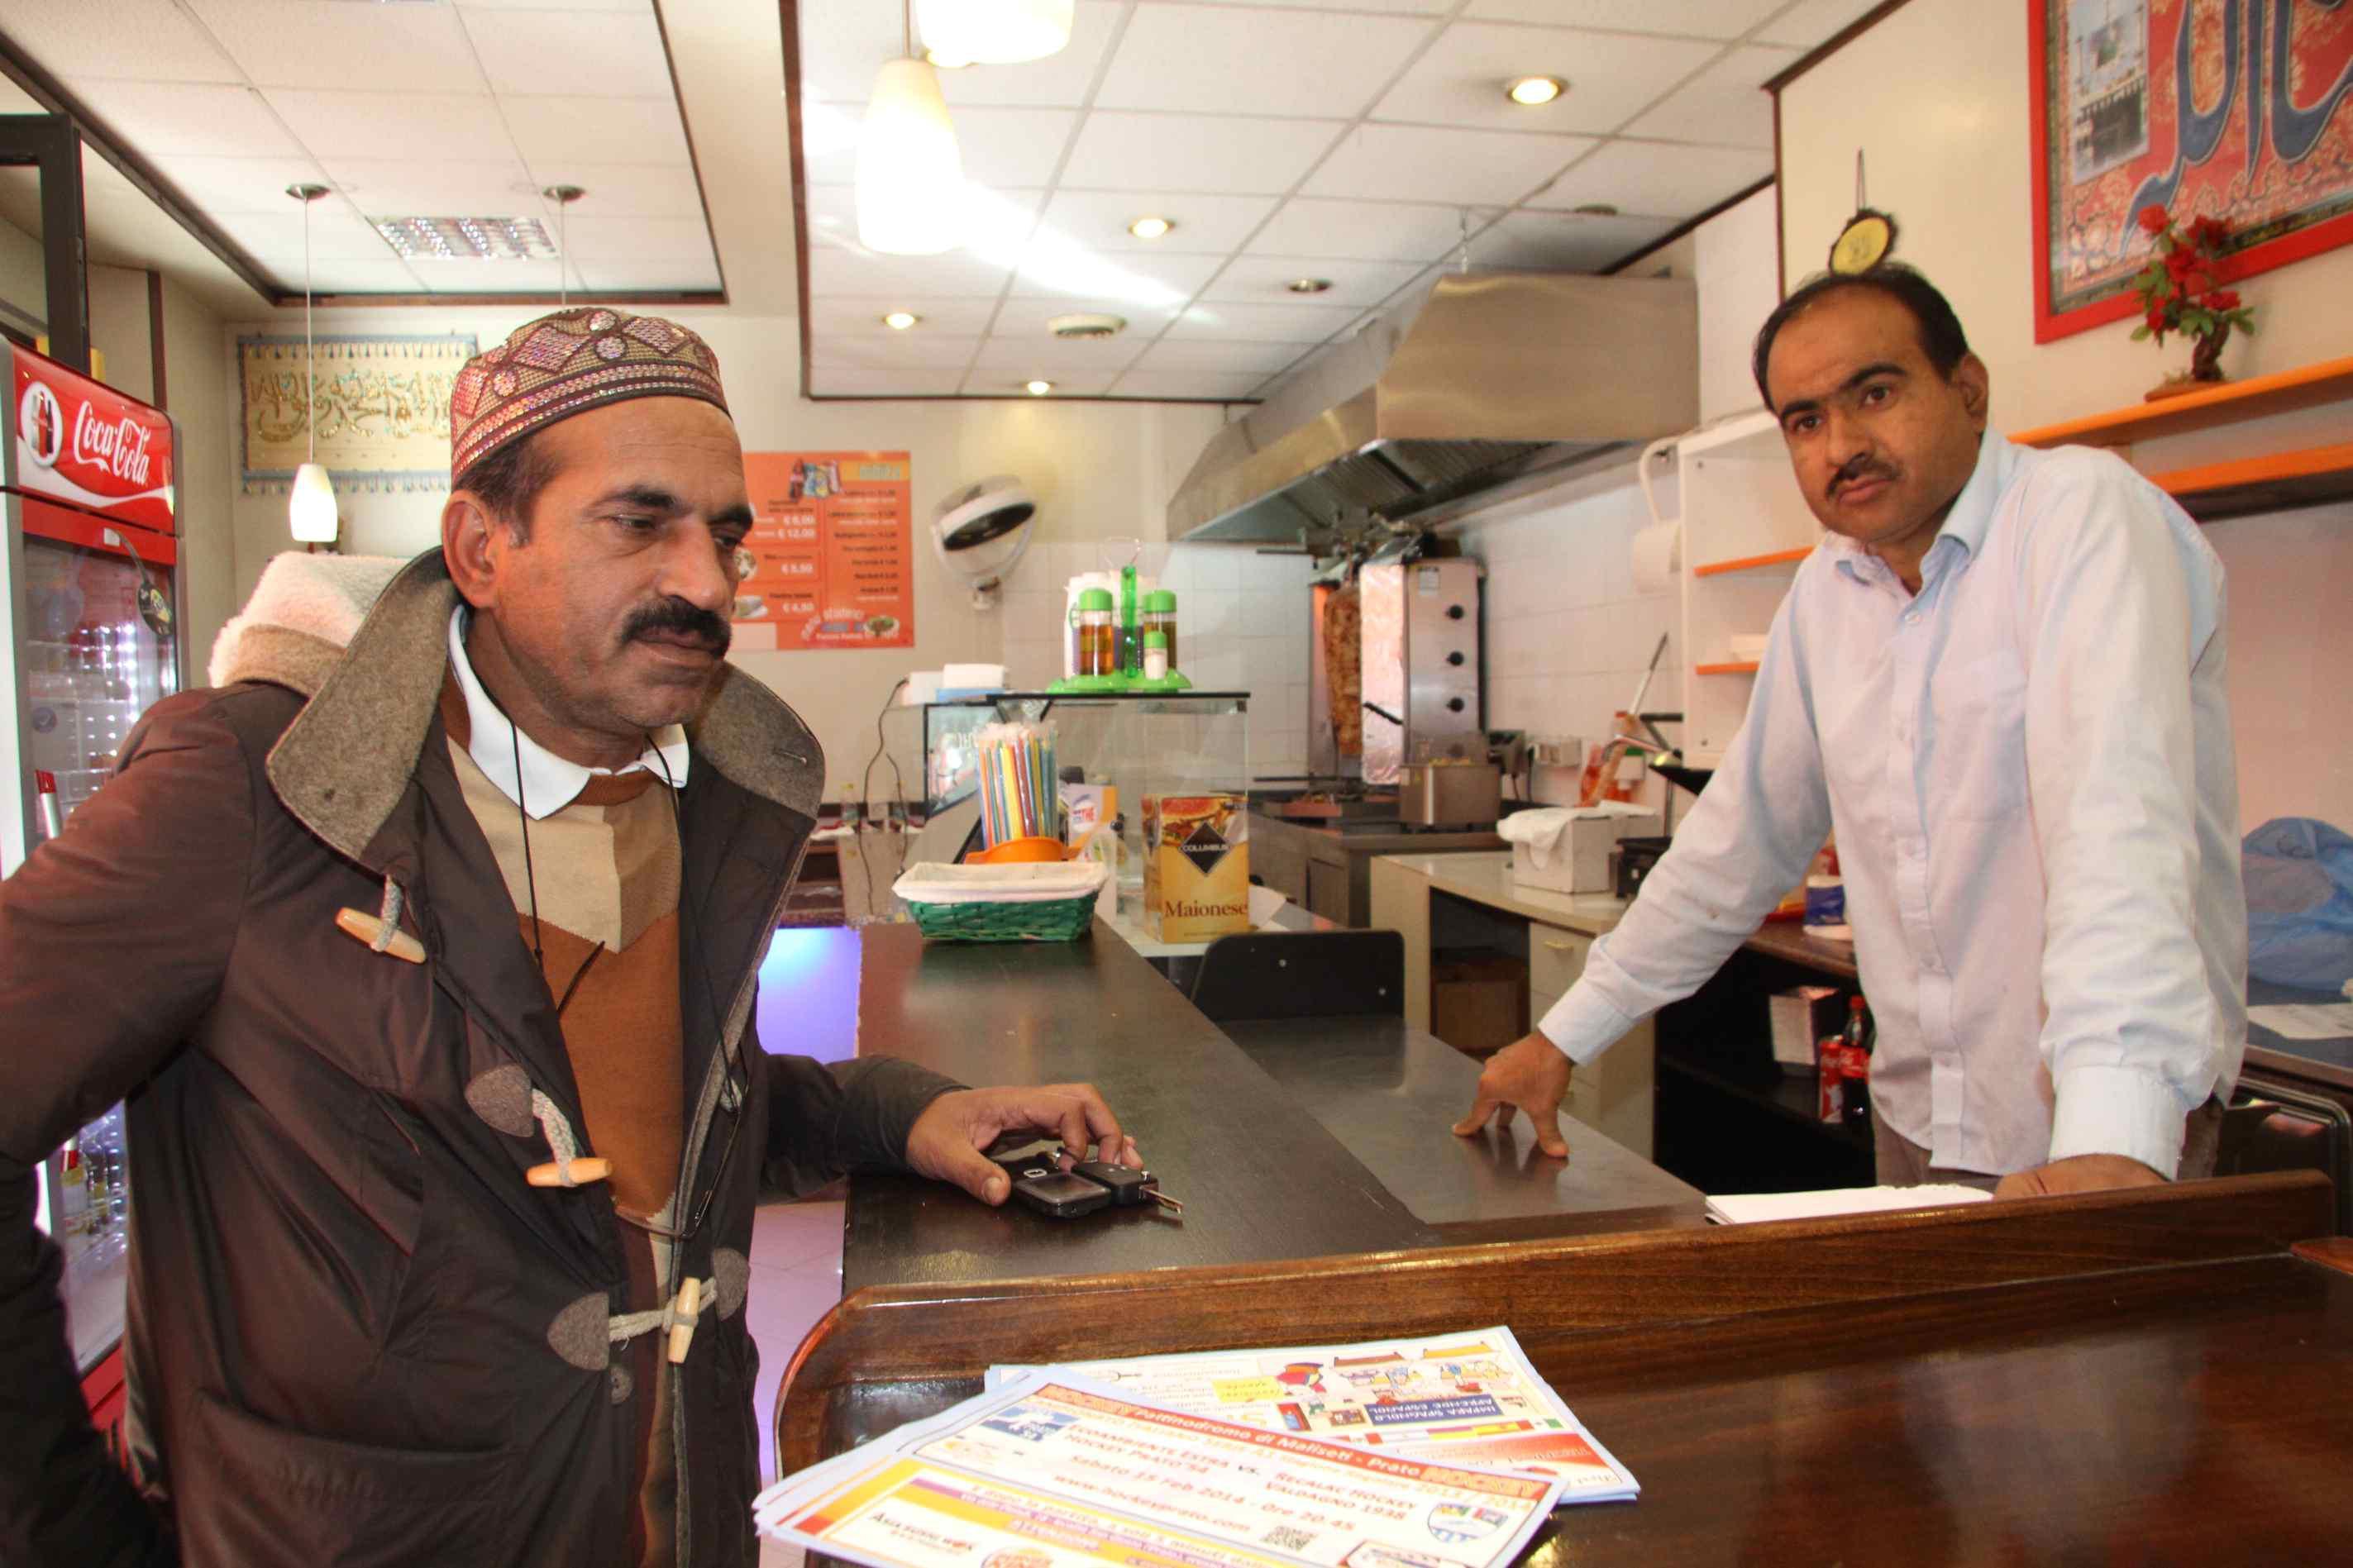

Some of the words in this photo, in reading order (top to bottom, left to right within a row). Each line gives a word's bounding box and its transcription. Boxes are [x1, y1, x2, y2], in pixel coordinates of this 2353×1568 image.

[73, 400, 151, 486] Coca-Cola
[1164, 899, 1248, 918] Maionese
[1277, 1437, 1353, 1461] Maliseti
[1367, 1456, 1420, 1476] Prato
